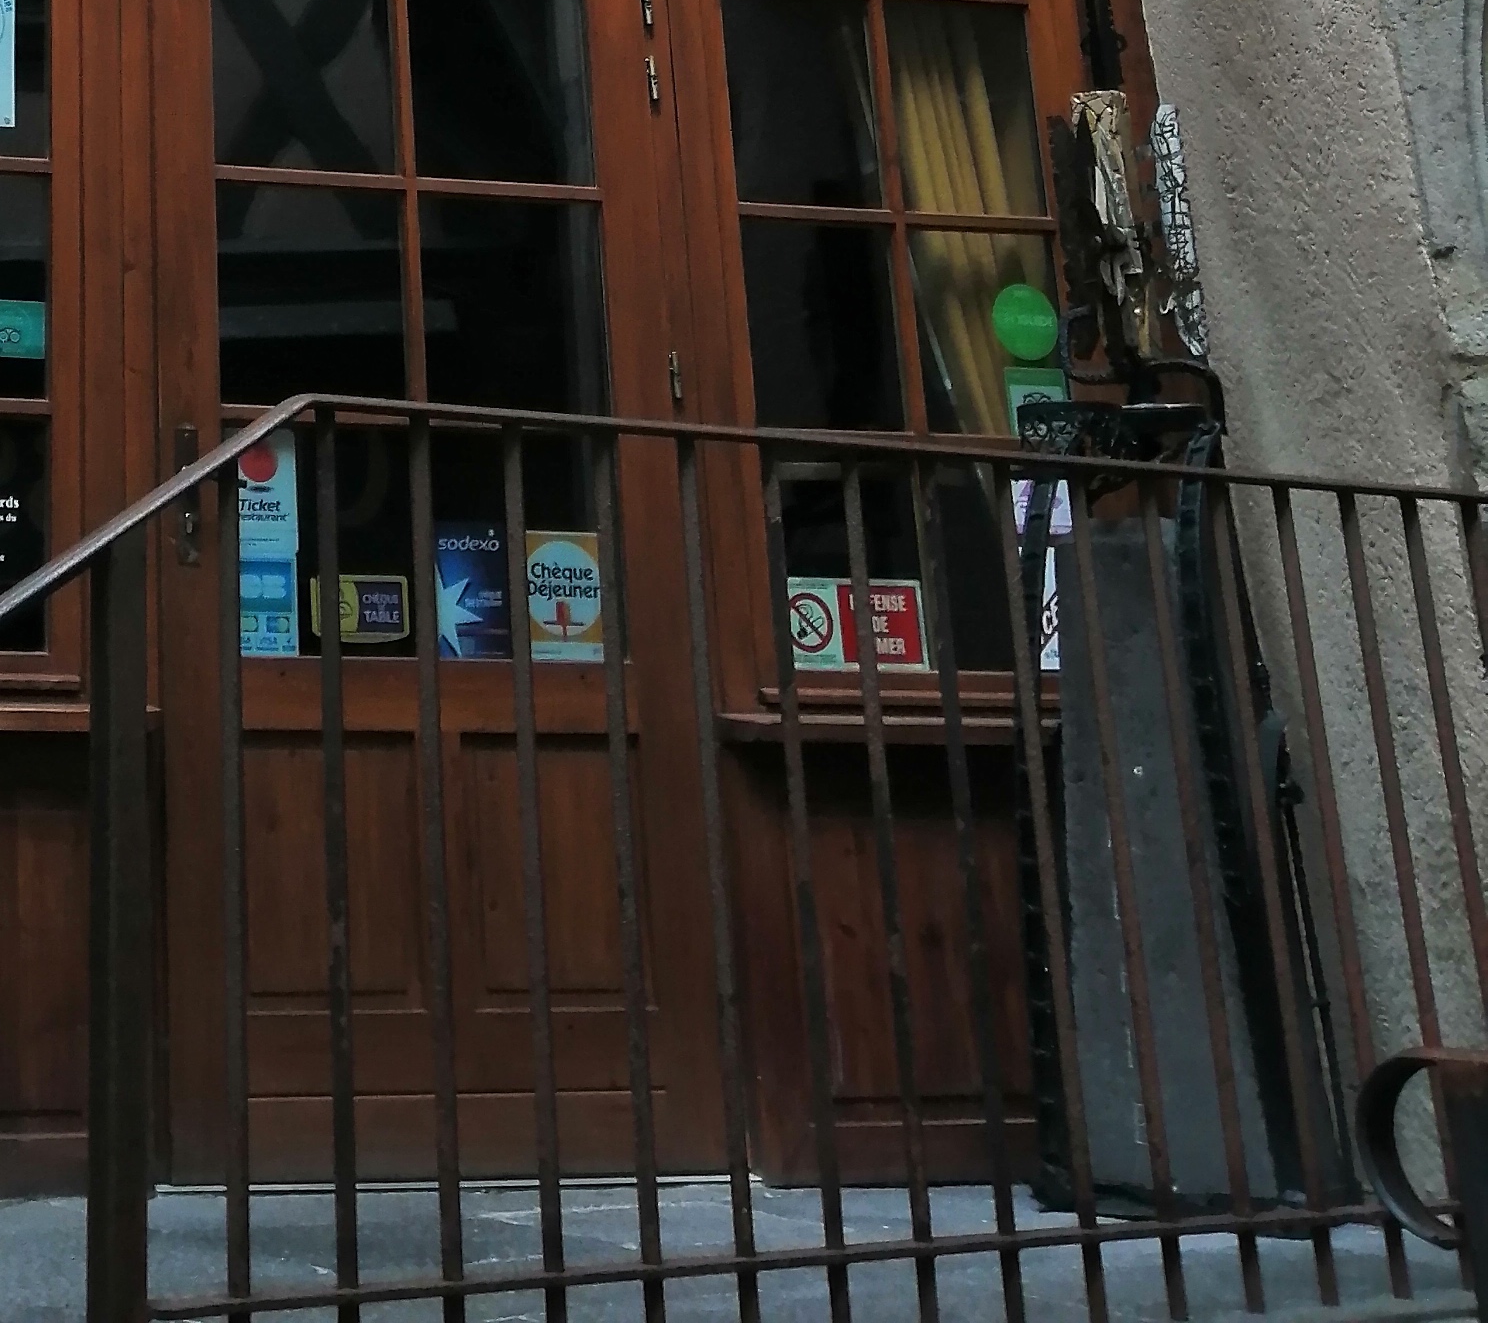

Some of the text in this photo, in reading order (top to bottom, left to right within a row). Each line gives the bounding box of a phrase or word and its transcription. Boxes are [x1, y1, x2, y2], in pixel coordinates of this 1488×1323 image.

[239, 498, 281, 512] Ticket
[5, 512, 17, 522] du
[240, 513, 287, 523] estaurant
[438, 535, 500, 552] sodexo
[531, 561, 594, 583] Chèque
[527, 579, 600, 602] Déjeuner
[363, 610, 400, 623] TABLE
[875, 636, 906, 655] MER
